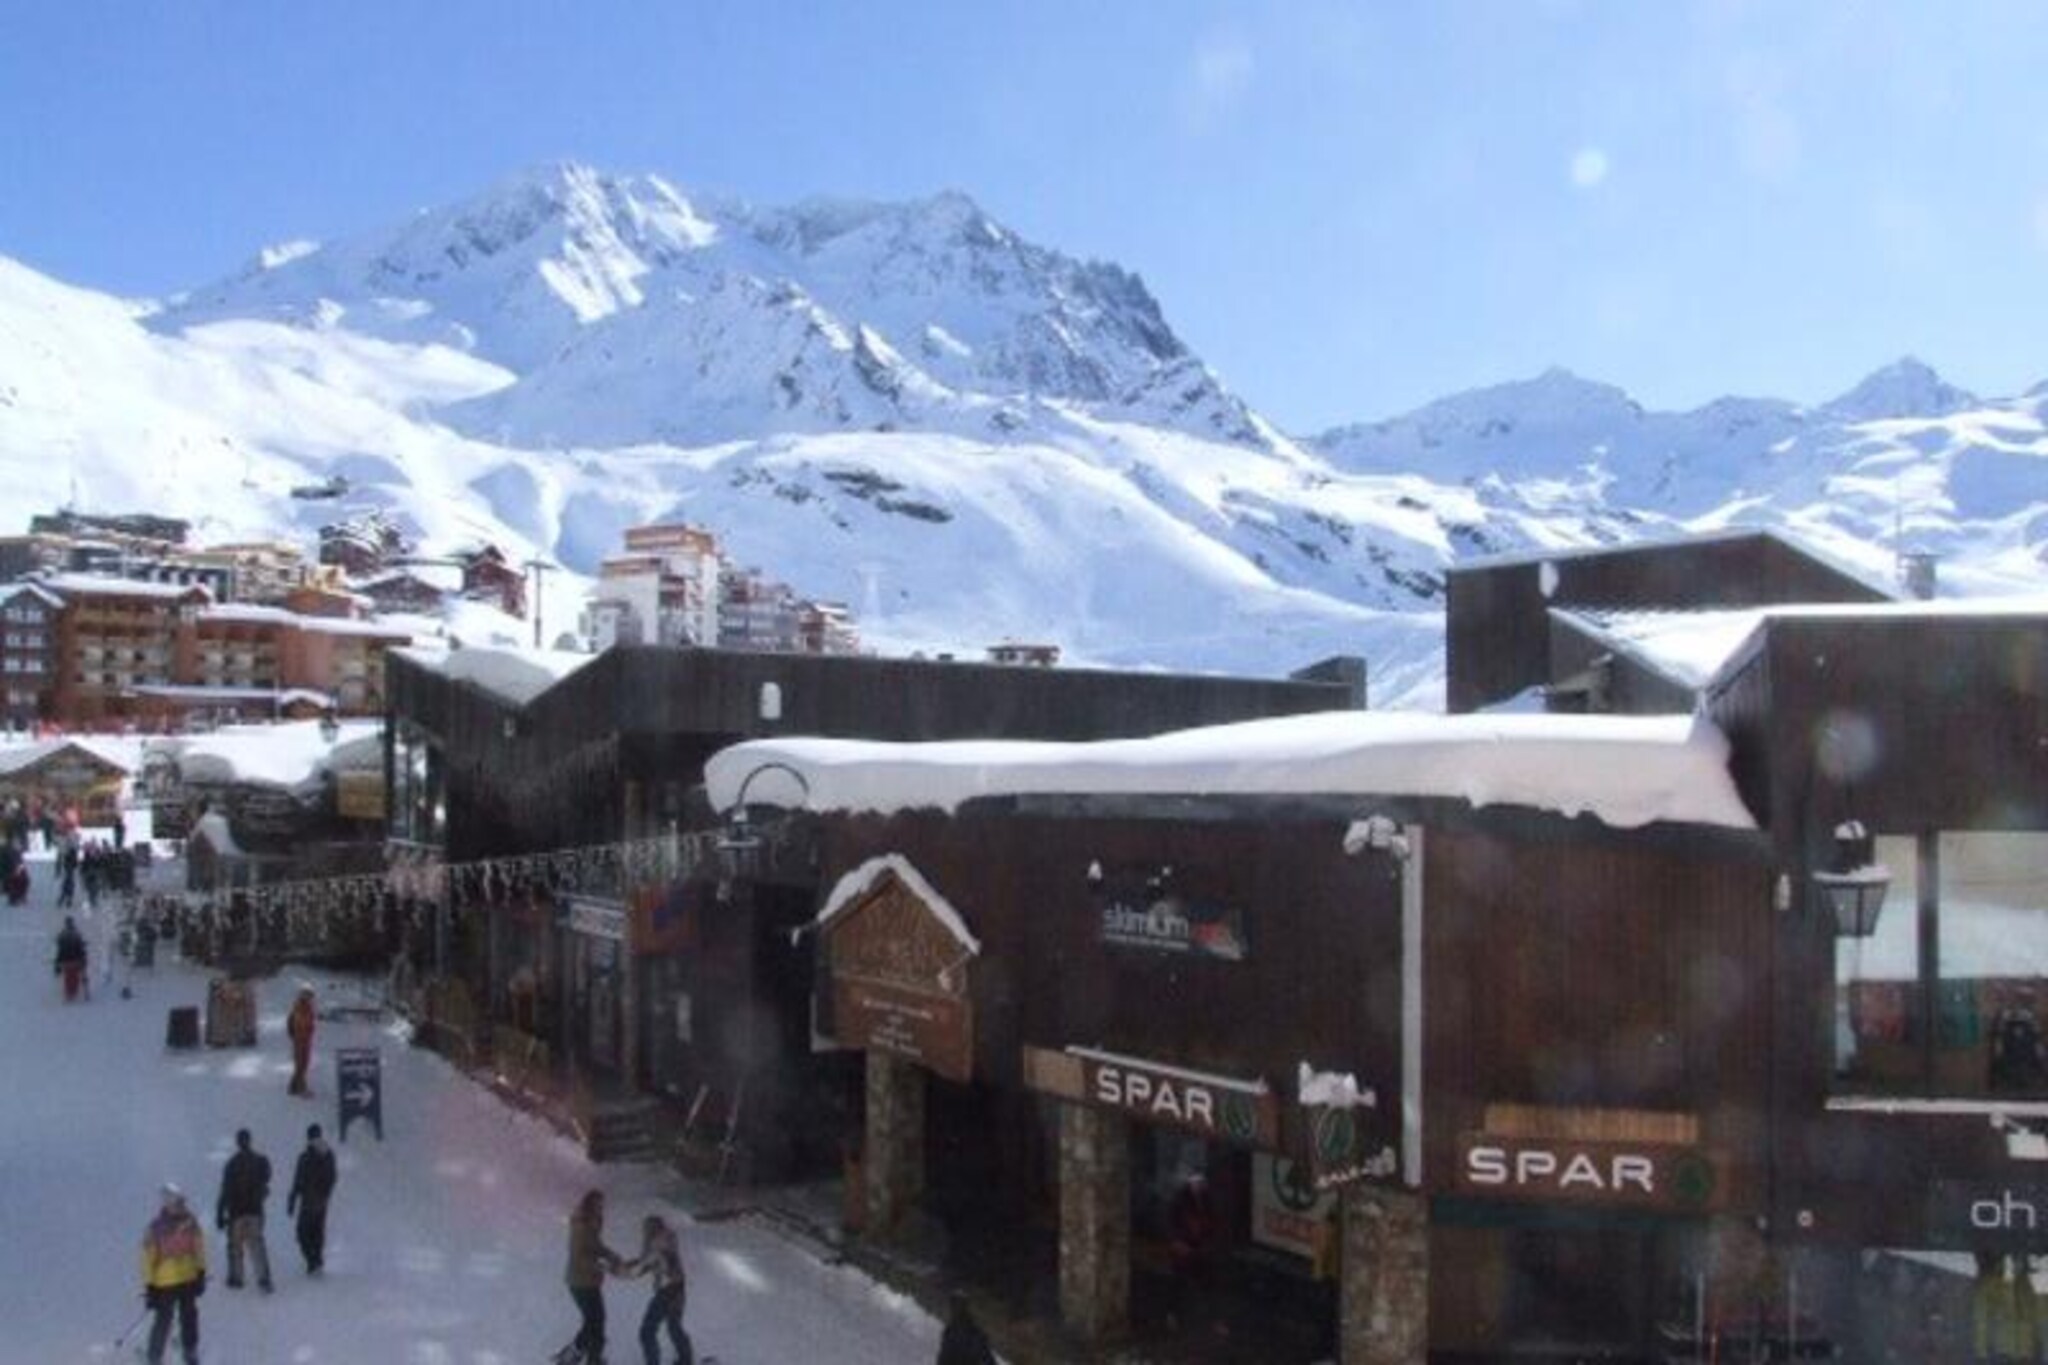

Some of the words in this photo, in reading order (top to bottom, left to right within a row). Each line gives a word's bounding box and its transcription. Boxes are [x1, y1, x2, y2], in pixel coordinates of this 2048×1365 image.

[1096, 1068, 1214, 1126] SPAR
[1468, 1147, 1654, 1192] SPAR
[1970, 1189, 2037, 1228] oh
